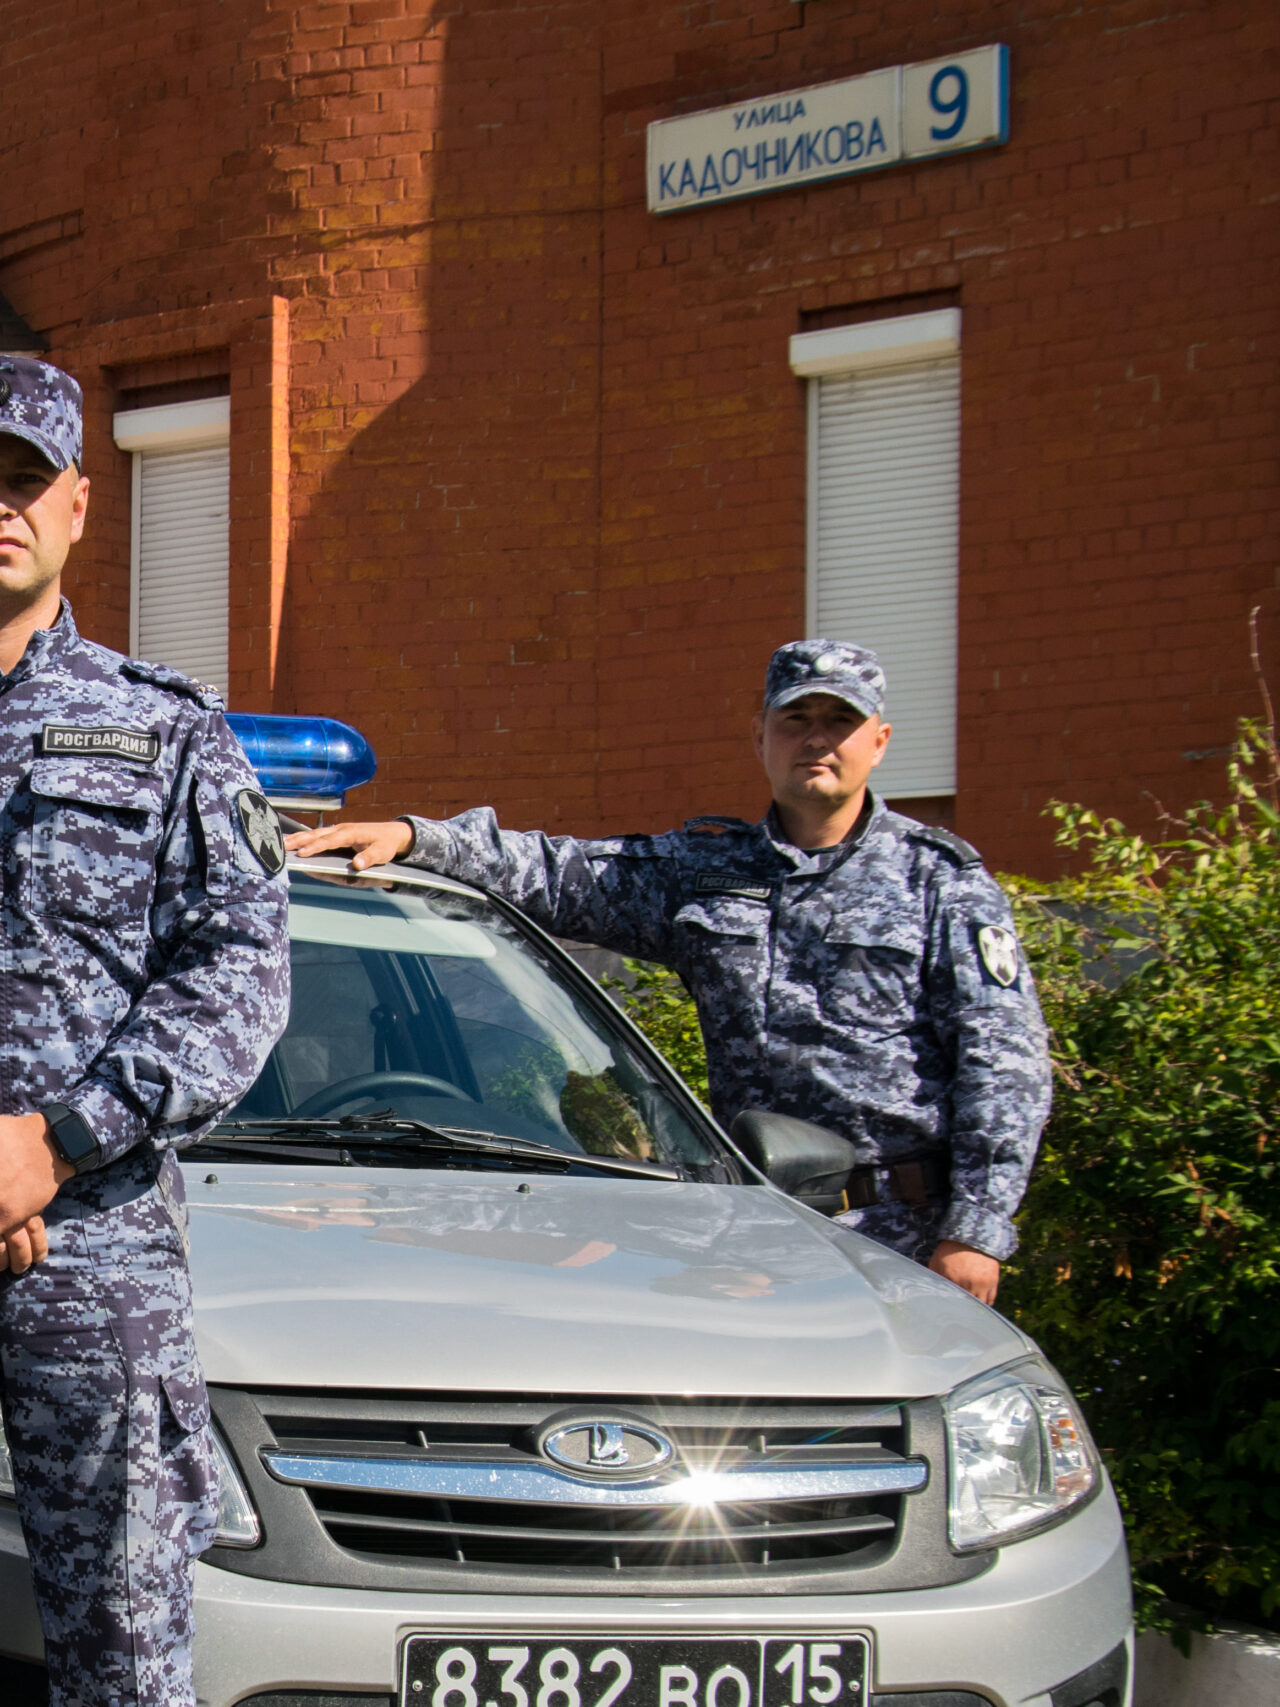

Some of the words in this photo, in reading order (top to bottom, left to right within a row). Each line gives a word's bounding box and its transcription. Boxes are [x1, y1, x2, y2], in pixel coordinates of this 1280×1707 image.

[733, 99, 806, 131] УЛИЦА
[928, 65, 970, 142] 9
[659, 117, 887, 200] КАДОЧНИКОВА
[54, 732, 149, 754] РОСГВАРДИЯ
[432, 1646, 633, 1707] 8382
[659, 1665, 751, 1707] ВО
[774, 1643, 843, 1704] 15
